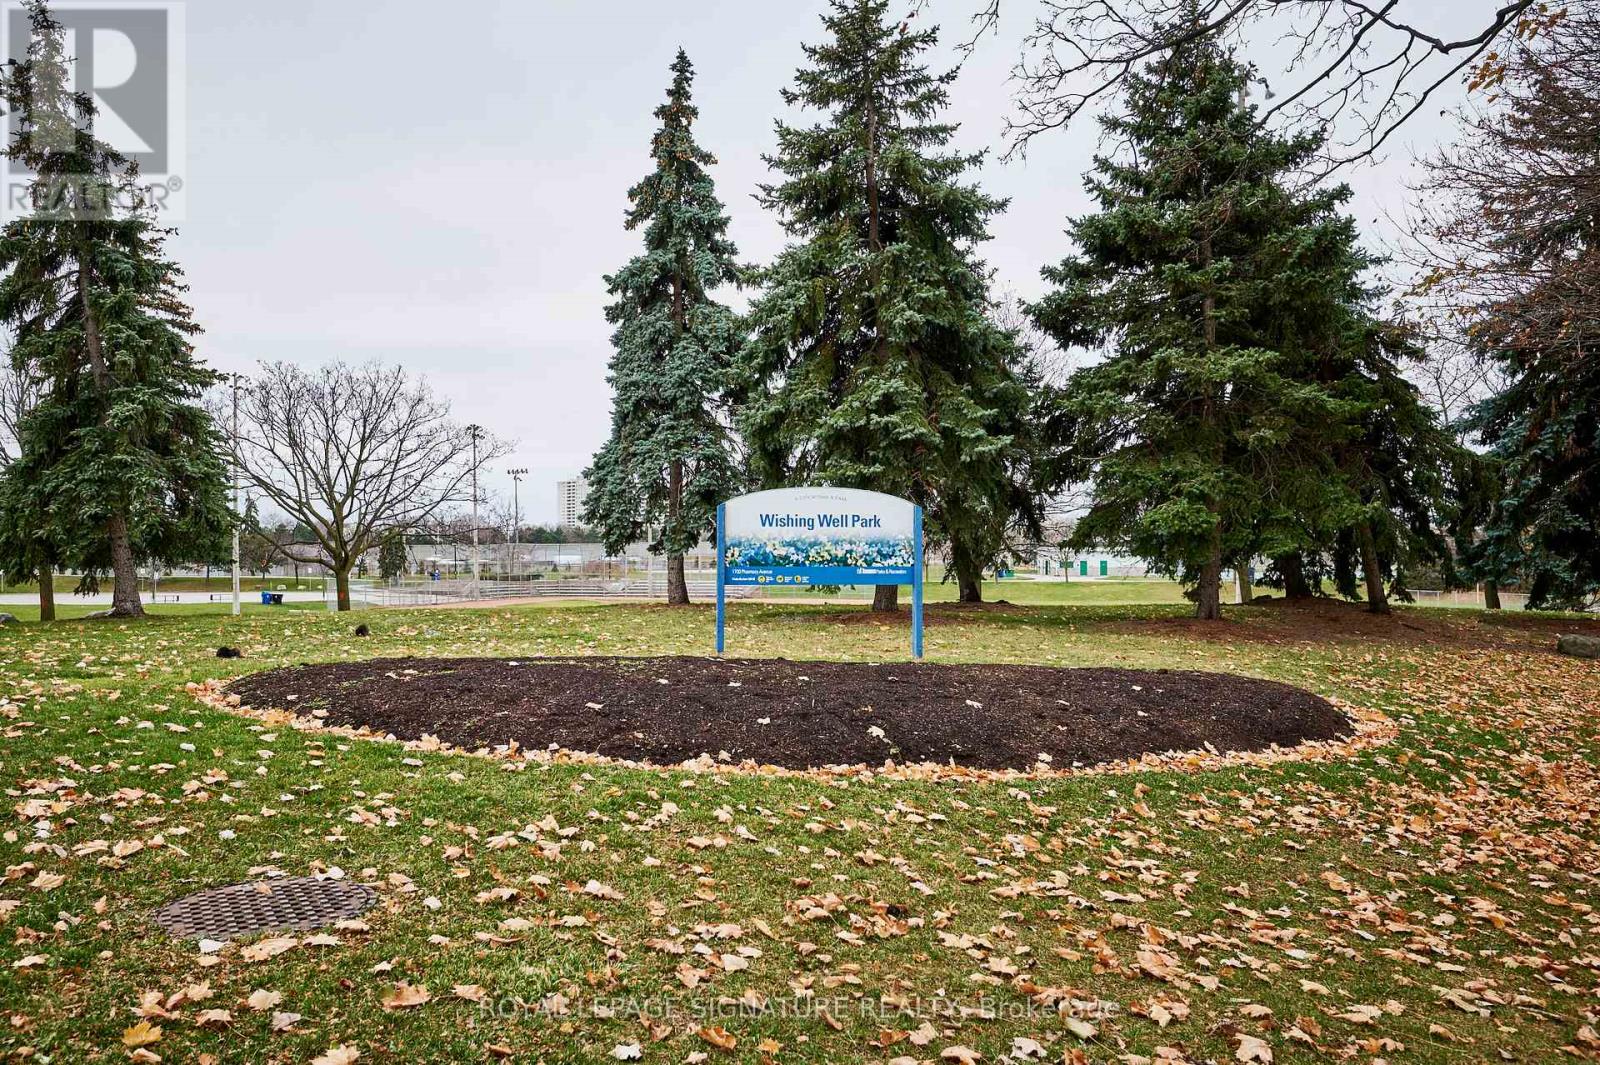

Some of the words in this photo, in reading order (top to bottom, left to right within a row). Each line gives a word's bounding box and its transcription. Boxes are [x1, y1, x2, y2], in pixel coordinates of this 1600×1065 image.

[759, 513, 814, 530] Wishing
[817, 513, 848, 528] Well
[851, 514, 881, 528] Park
